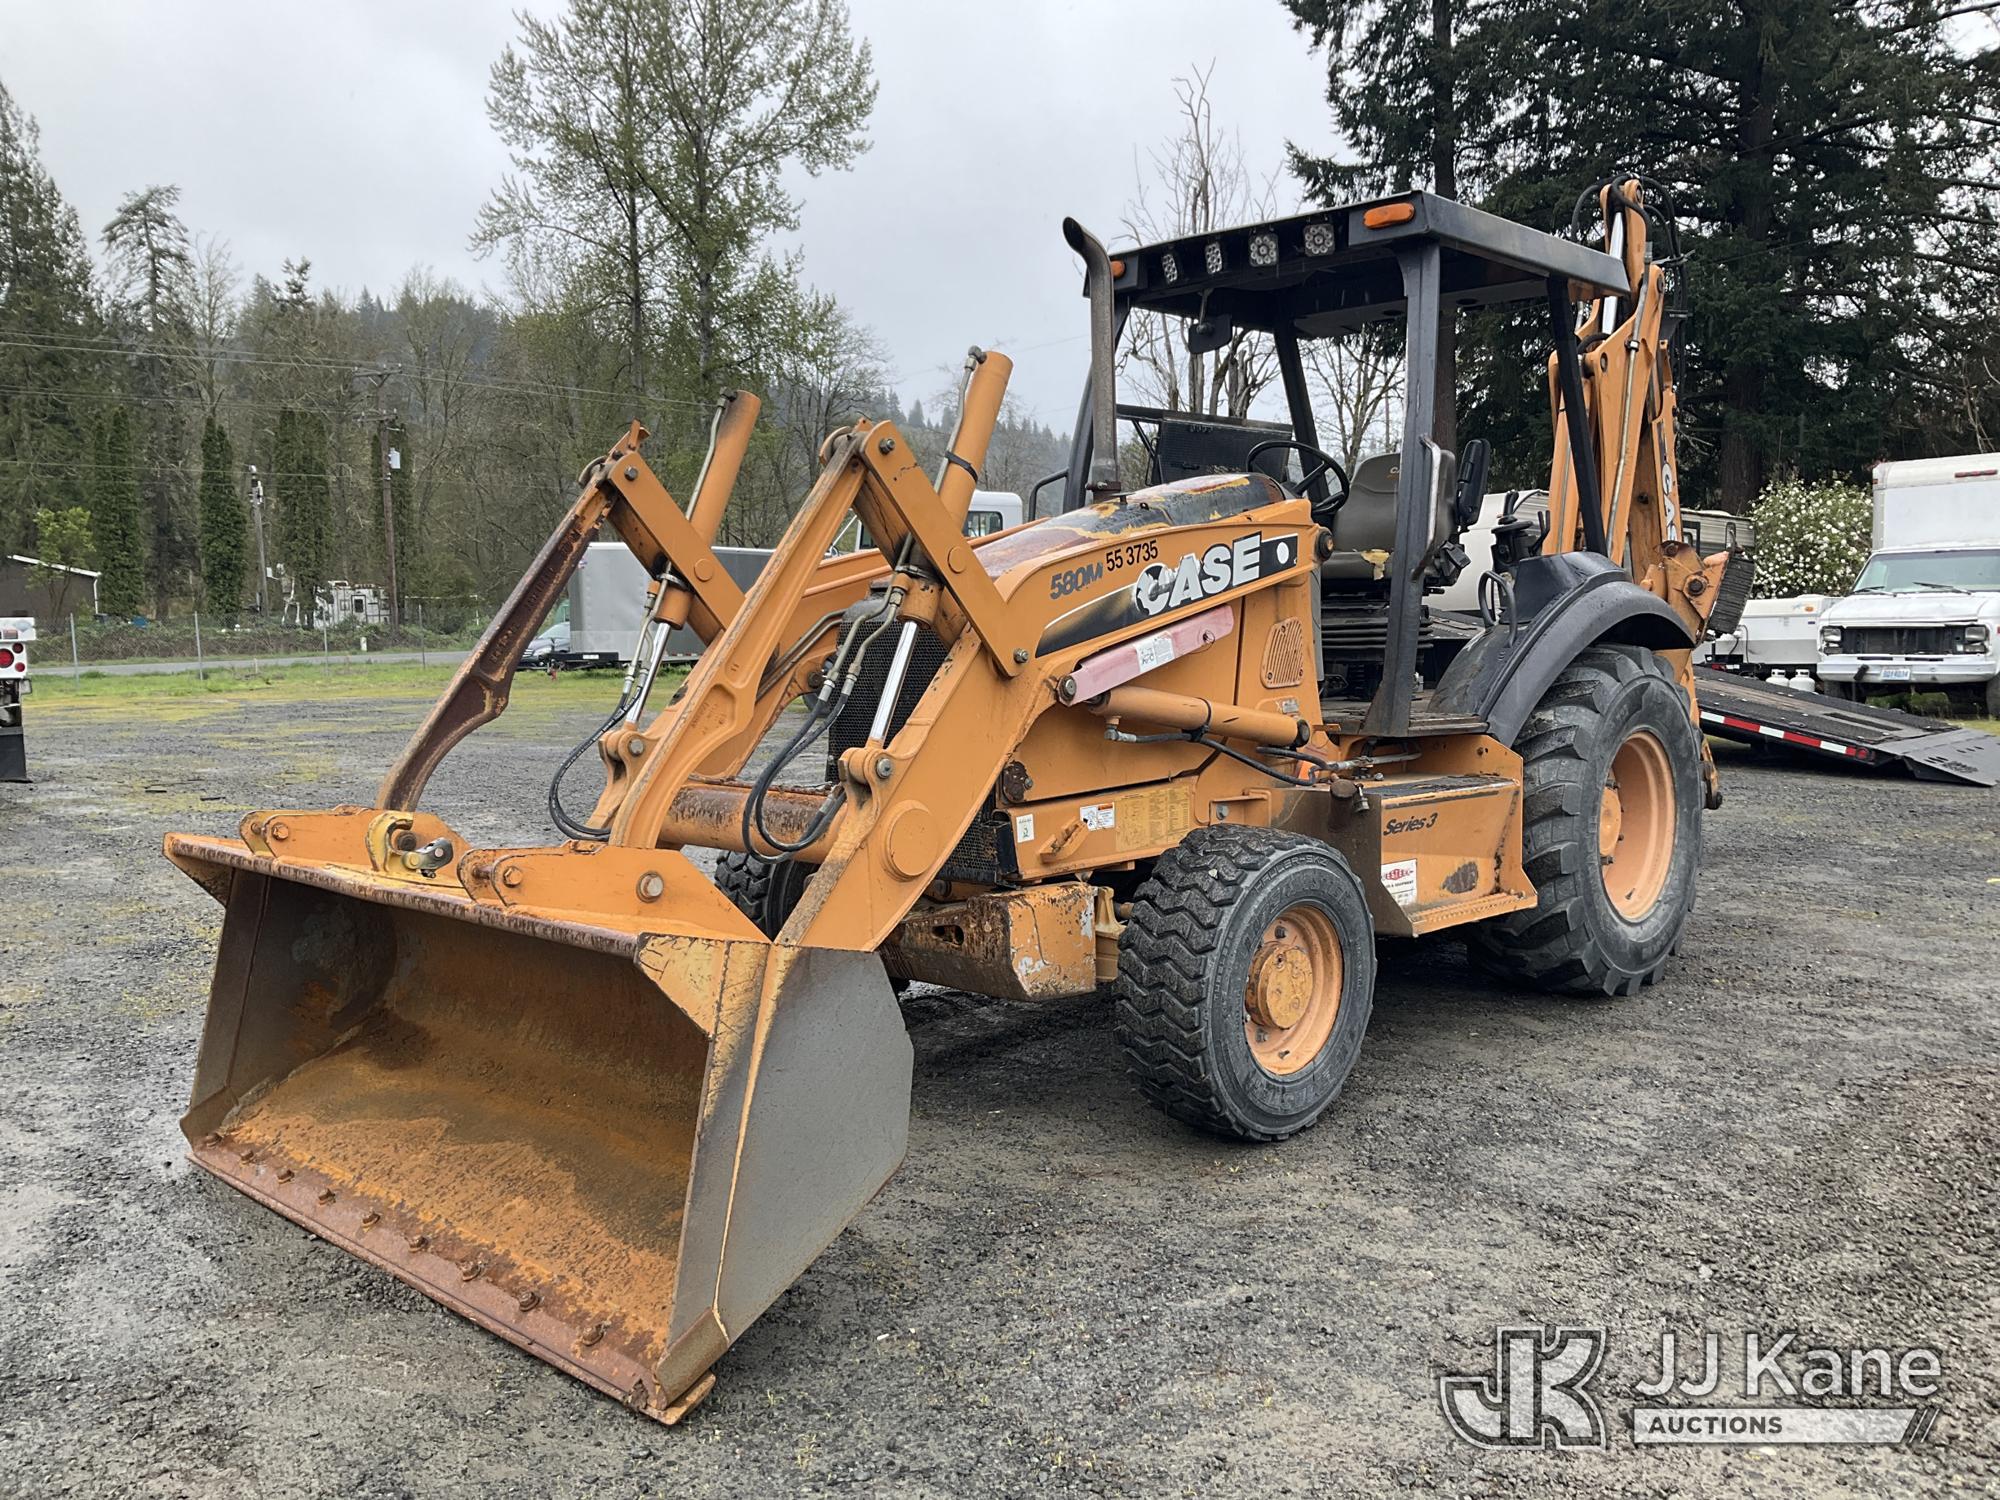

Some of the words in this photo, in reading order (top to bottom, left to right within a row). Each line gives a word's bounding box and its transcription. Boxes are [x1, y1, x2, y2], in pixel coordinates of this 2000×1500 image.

[1105, 549, 1124, 572] 55
[1125, 540, 1159, 566] 3735
[1136, 532, 1262, 616] CASE
[1050, 560, 1104, 600] 580M
[1383, 815, 1427, 837] Series
[1426, 812, 1439, 829] 3
